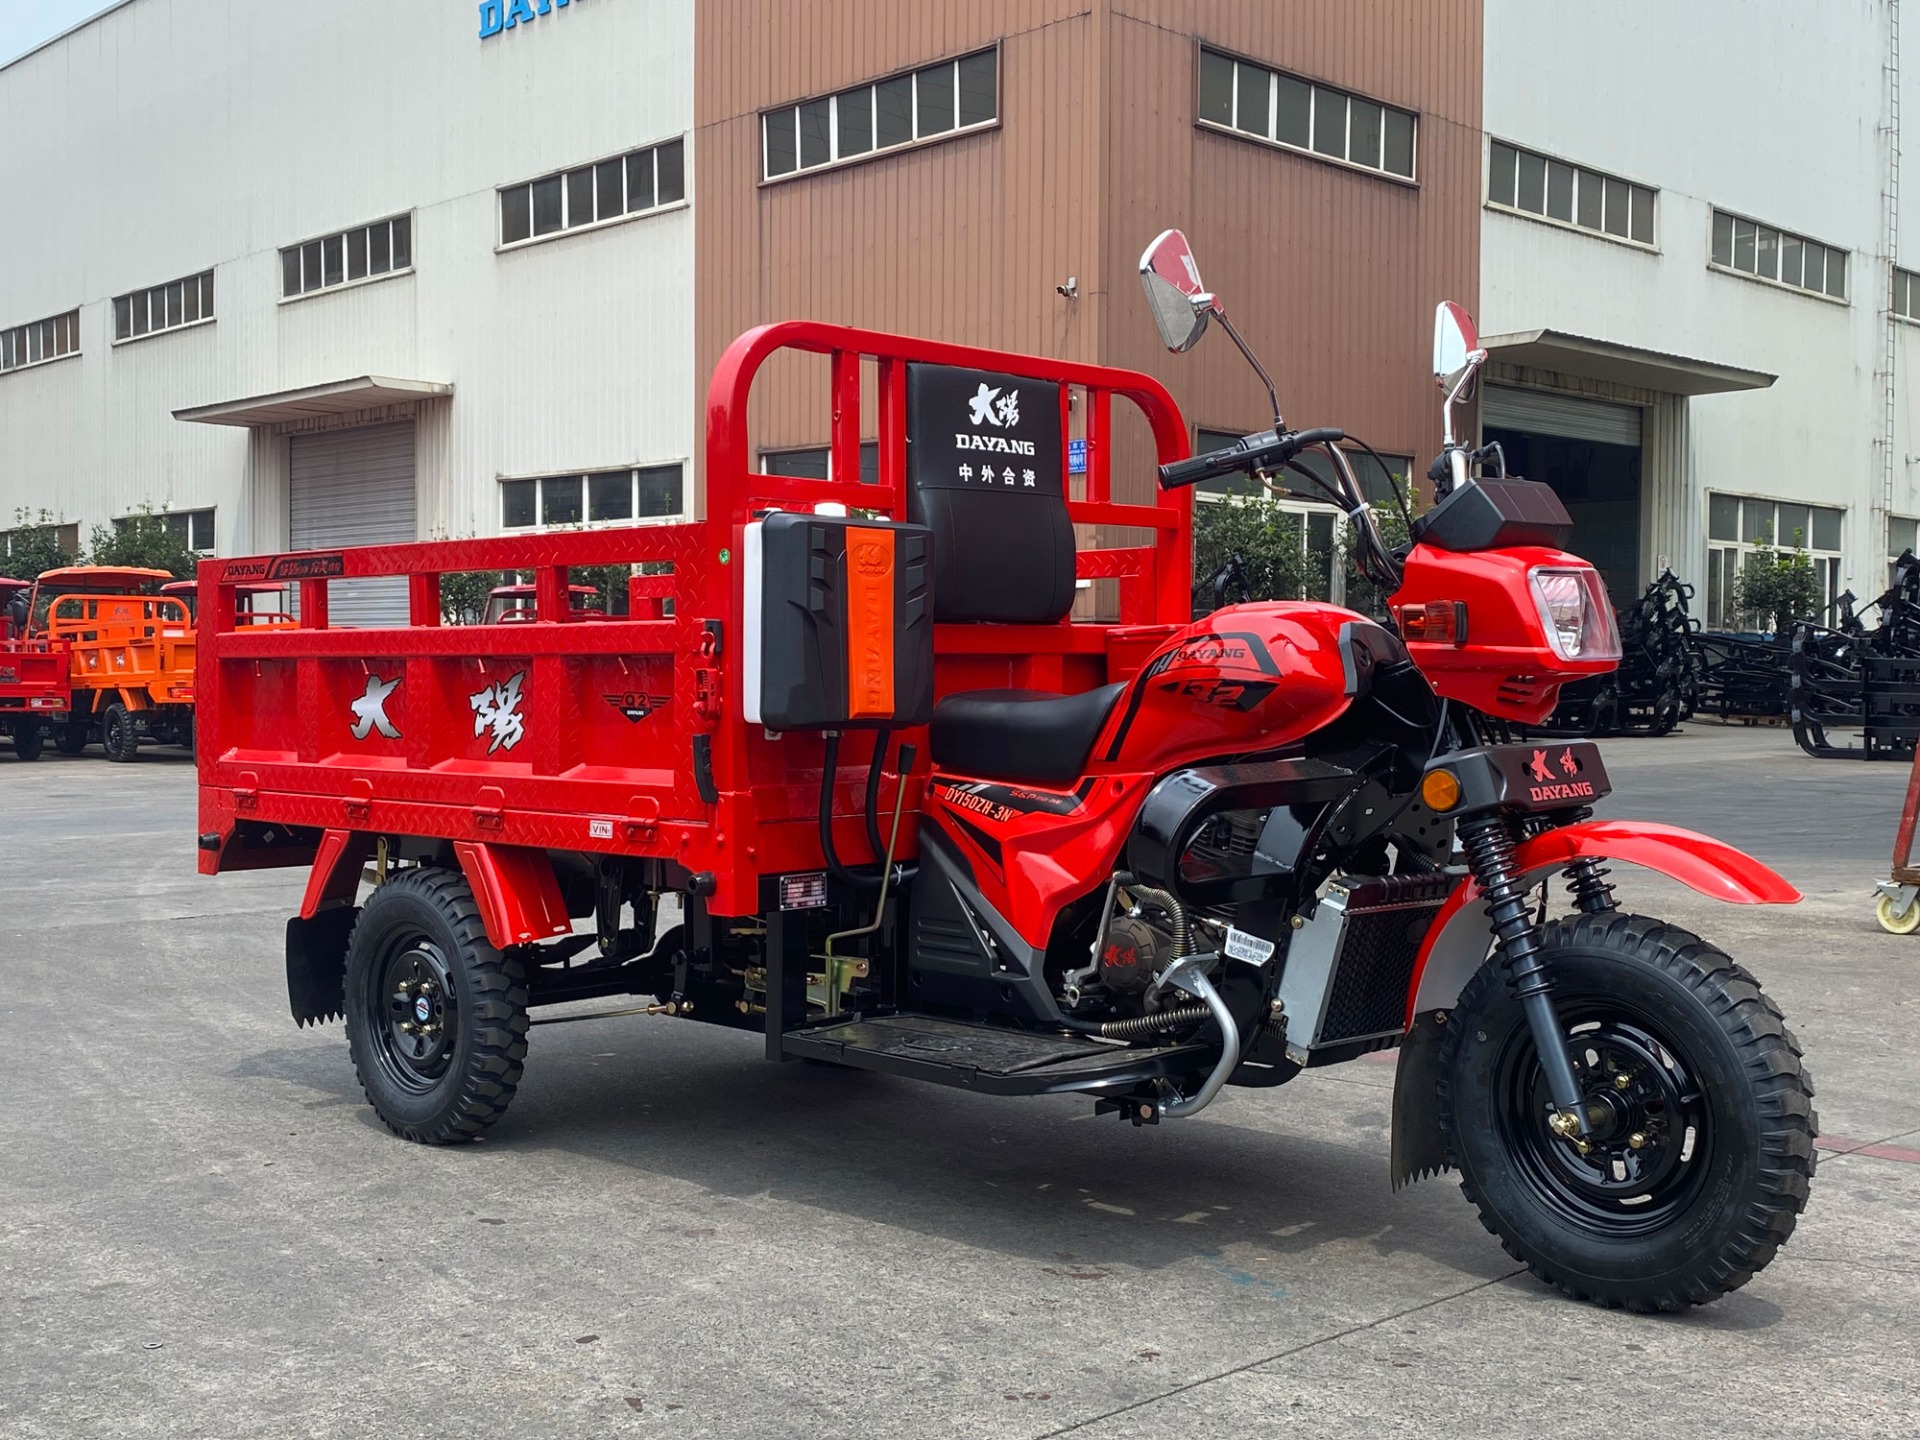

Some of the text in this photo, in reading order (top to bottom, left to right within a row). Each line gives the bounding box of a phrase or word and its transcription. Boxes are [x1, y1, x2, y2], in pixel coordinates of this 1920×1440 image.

[955, 434, 1035, 456] DAYANG
[959, 463, 1036, 487] 中外合资
[227, 564, 266, 576] DAYANG
[865, 586, 882, 709] DAYANG
[1177, 648, 1246, 661] DAYANG
[1529, 781, 1594, 802] DAYANG
[944, 786, 1014, 823] DY150ZH-3N
